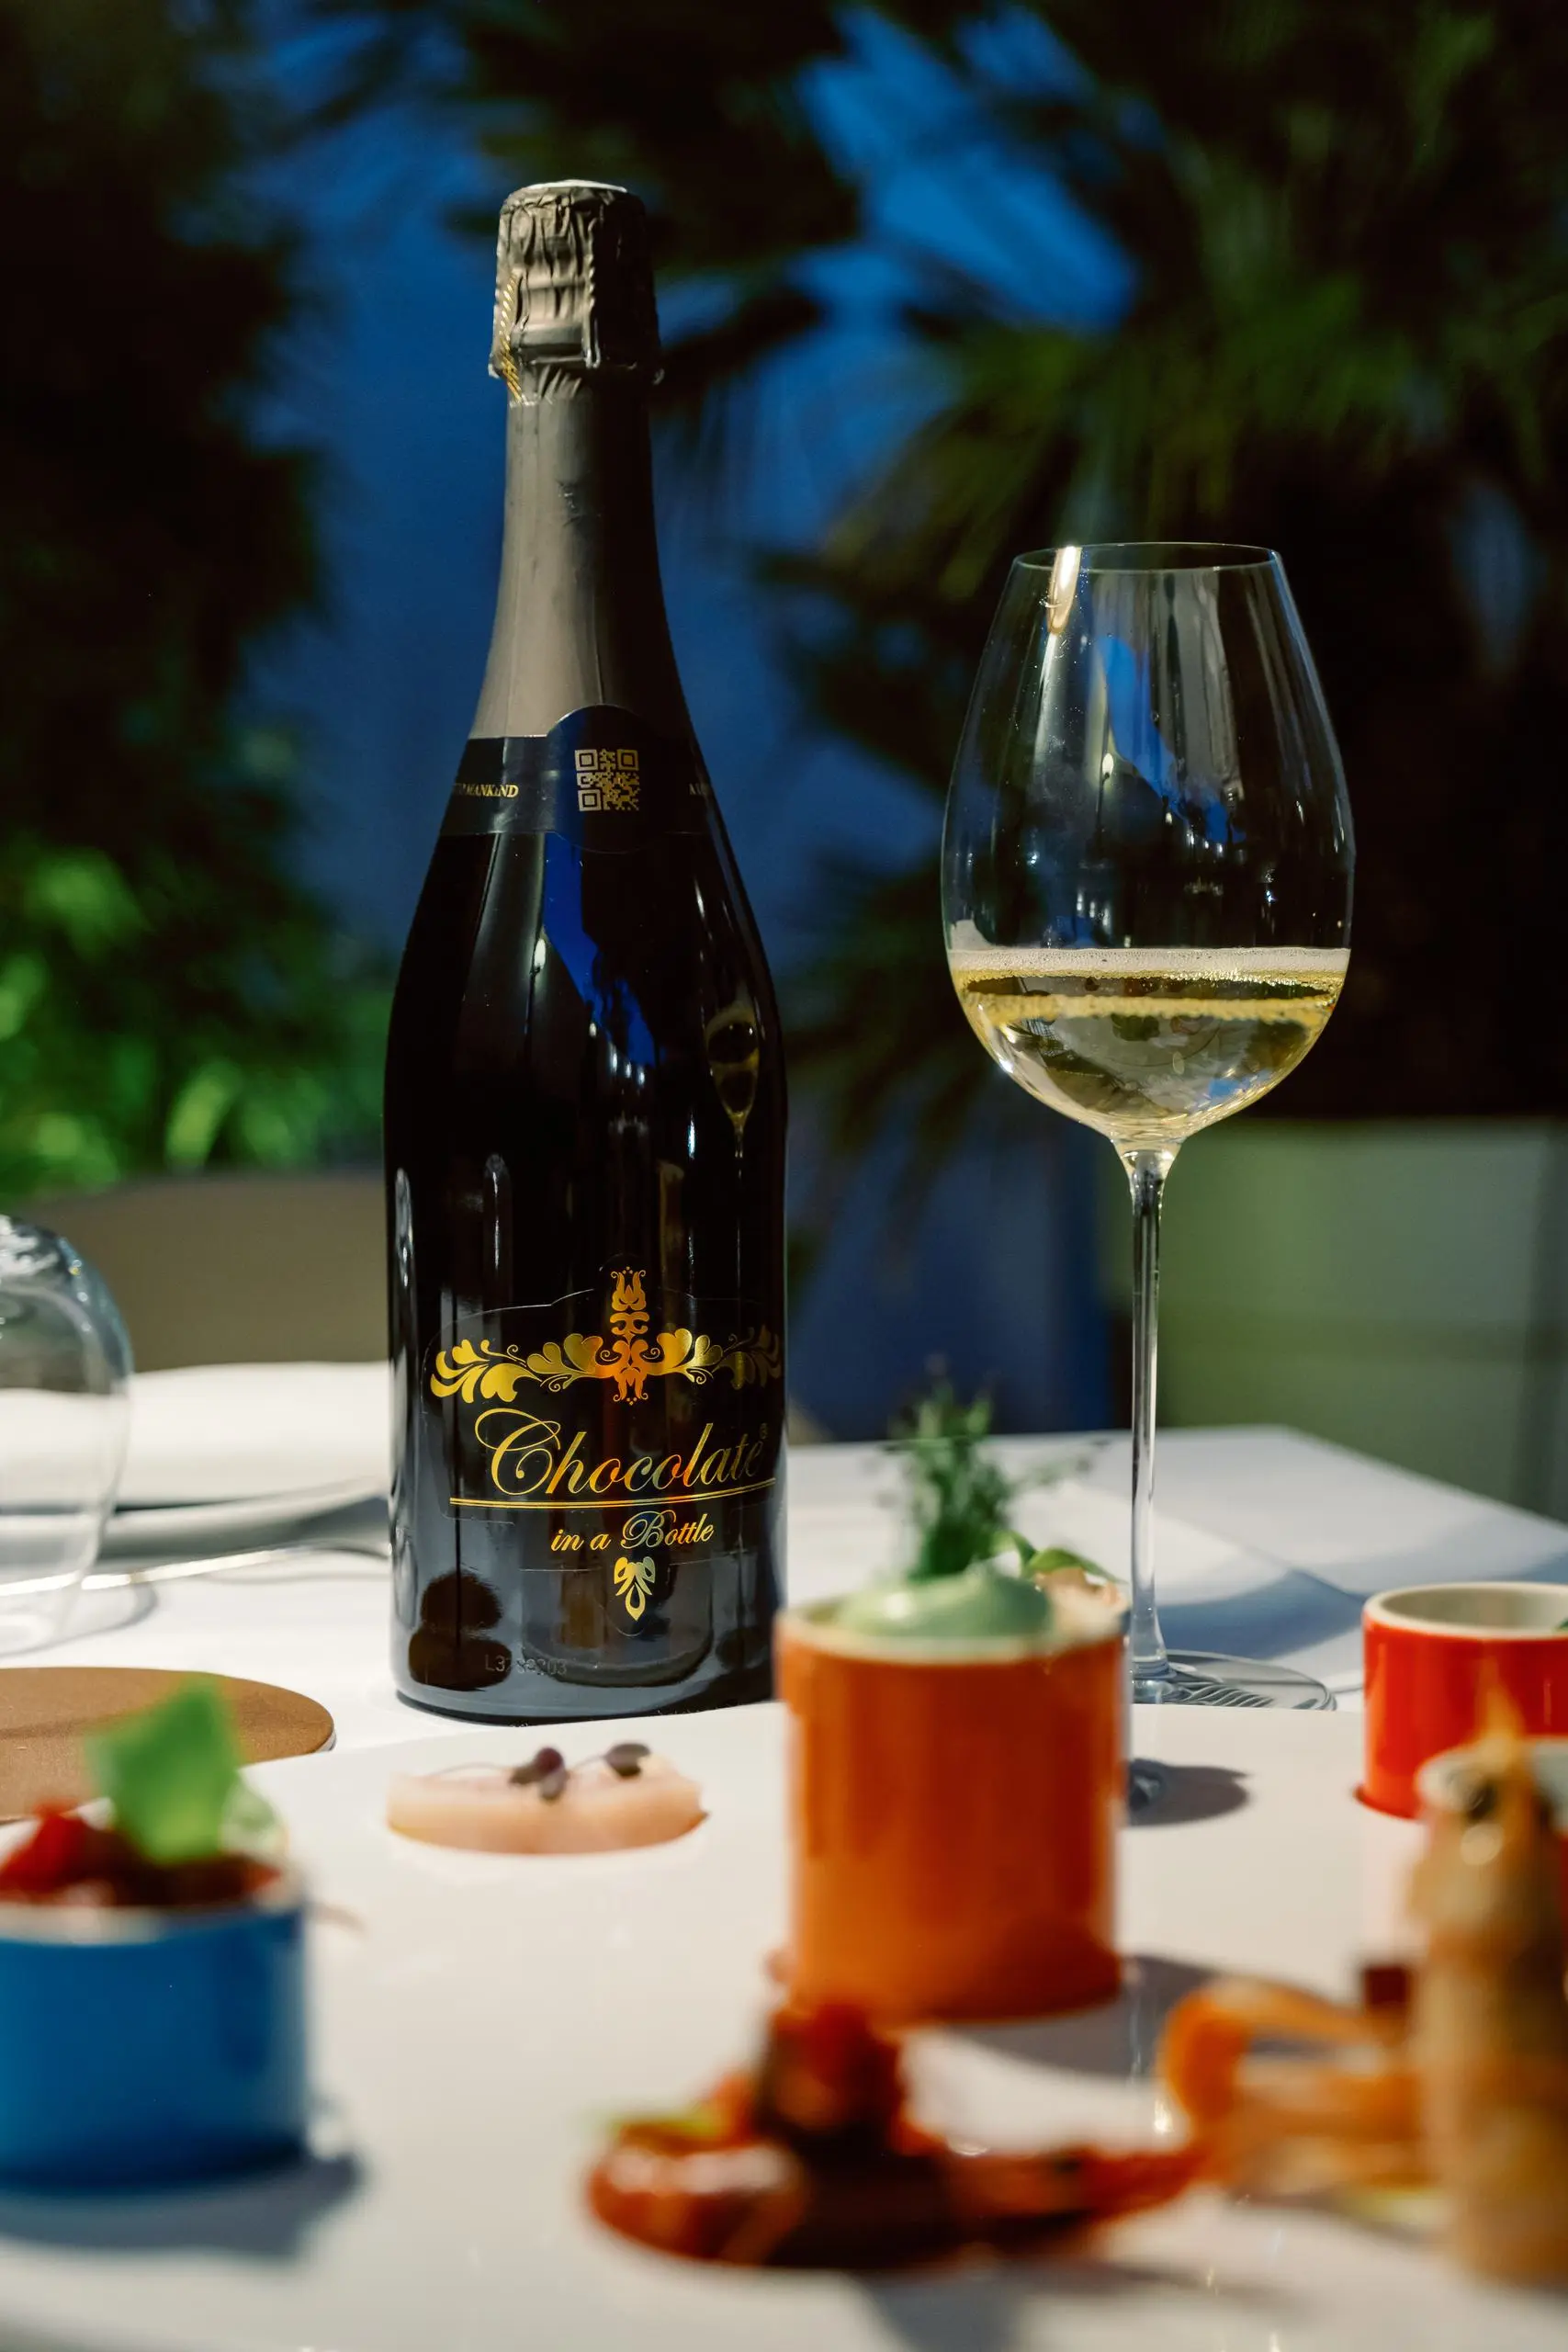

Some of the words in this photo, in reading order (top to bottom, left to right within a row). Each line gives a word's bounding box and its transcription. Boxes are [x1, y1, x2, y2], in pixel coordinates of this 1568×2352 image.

[474, 1408, 764, 1496] Chocolate
[551, 1529, 584, 1552] in
[590, 1533, 611, 1551] a
[621, 1510, 714, 1549] Bottle
